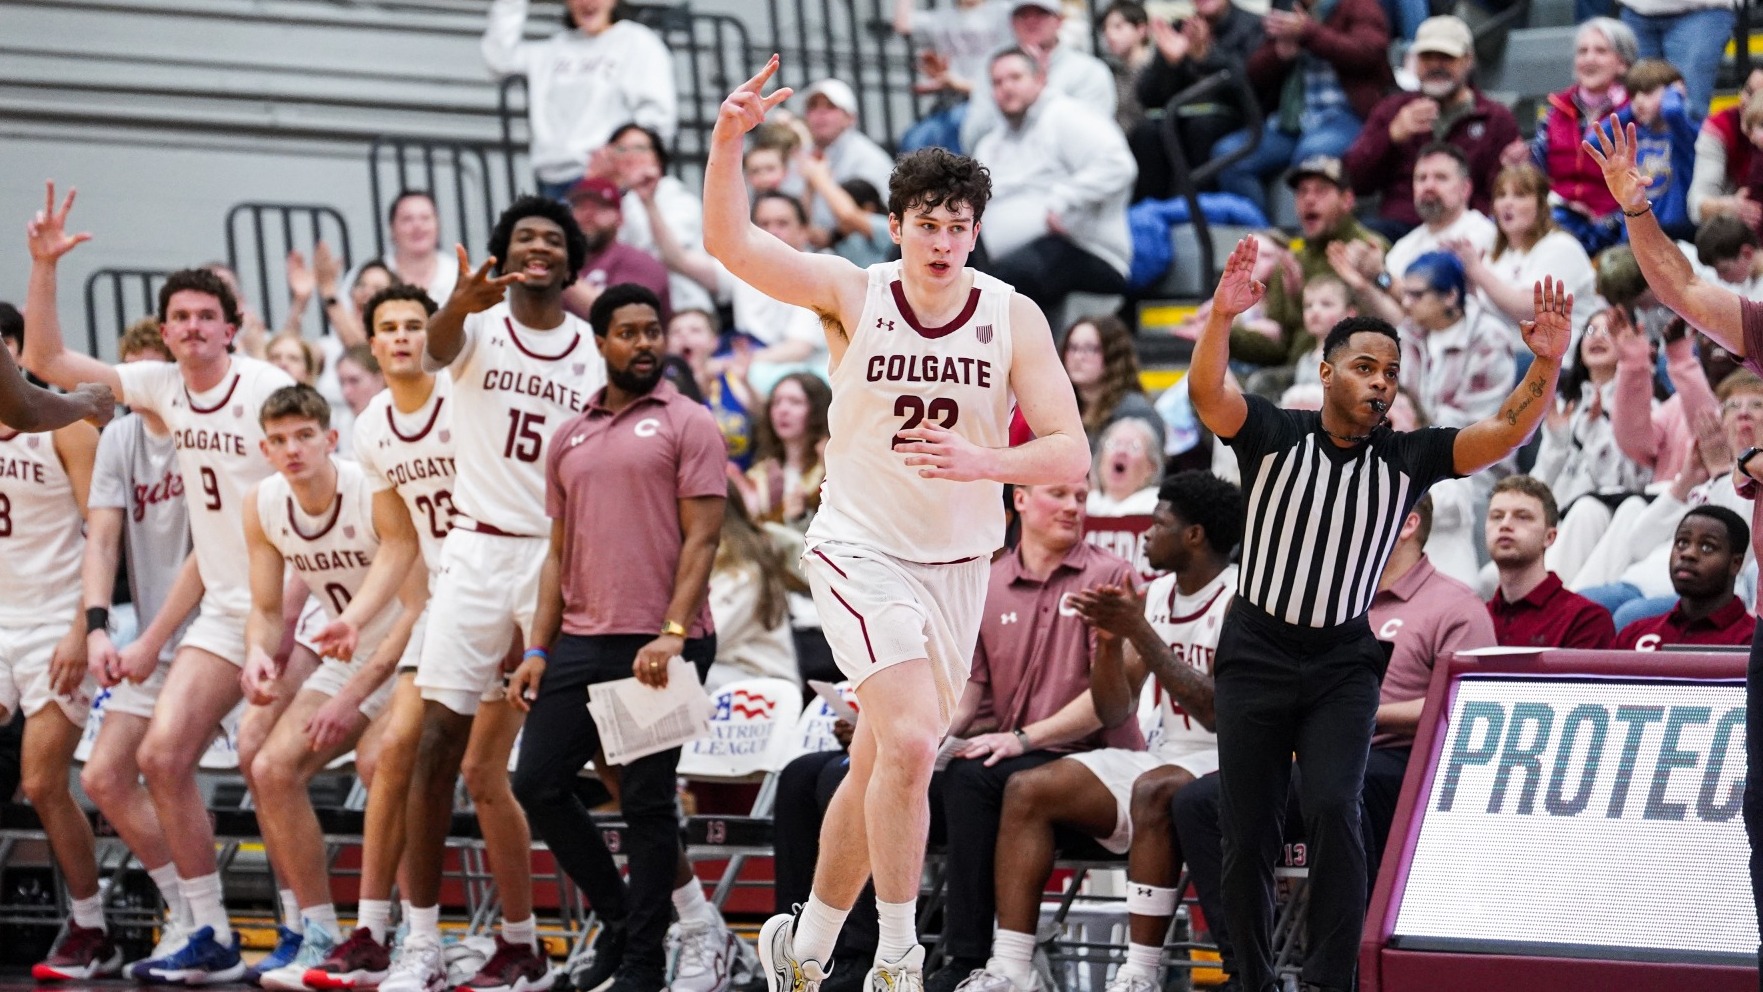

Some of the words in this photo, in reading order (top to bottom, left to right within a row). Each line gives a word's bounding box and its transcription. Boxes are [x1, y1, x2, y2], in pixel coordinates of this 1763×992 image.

[866, 354, 991, 389] COLGATE
[483, 369, 580, 413] COLGATE
[504, 407, 545, 463] 15
[634, 418, 660, 437] C
[891, 394, 959, 451] 22
[174, 428, 247, 456] COGATE
[200, 466, 222, 511] 9
[415, 489, 459, 538] 23
[1379, 618, 1403, 638] C
[710, 722, 775, 739] ATRIOT
[694, 738, 768, 756] LEAGU
[1283, 843, 1307, 866] 13
